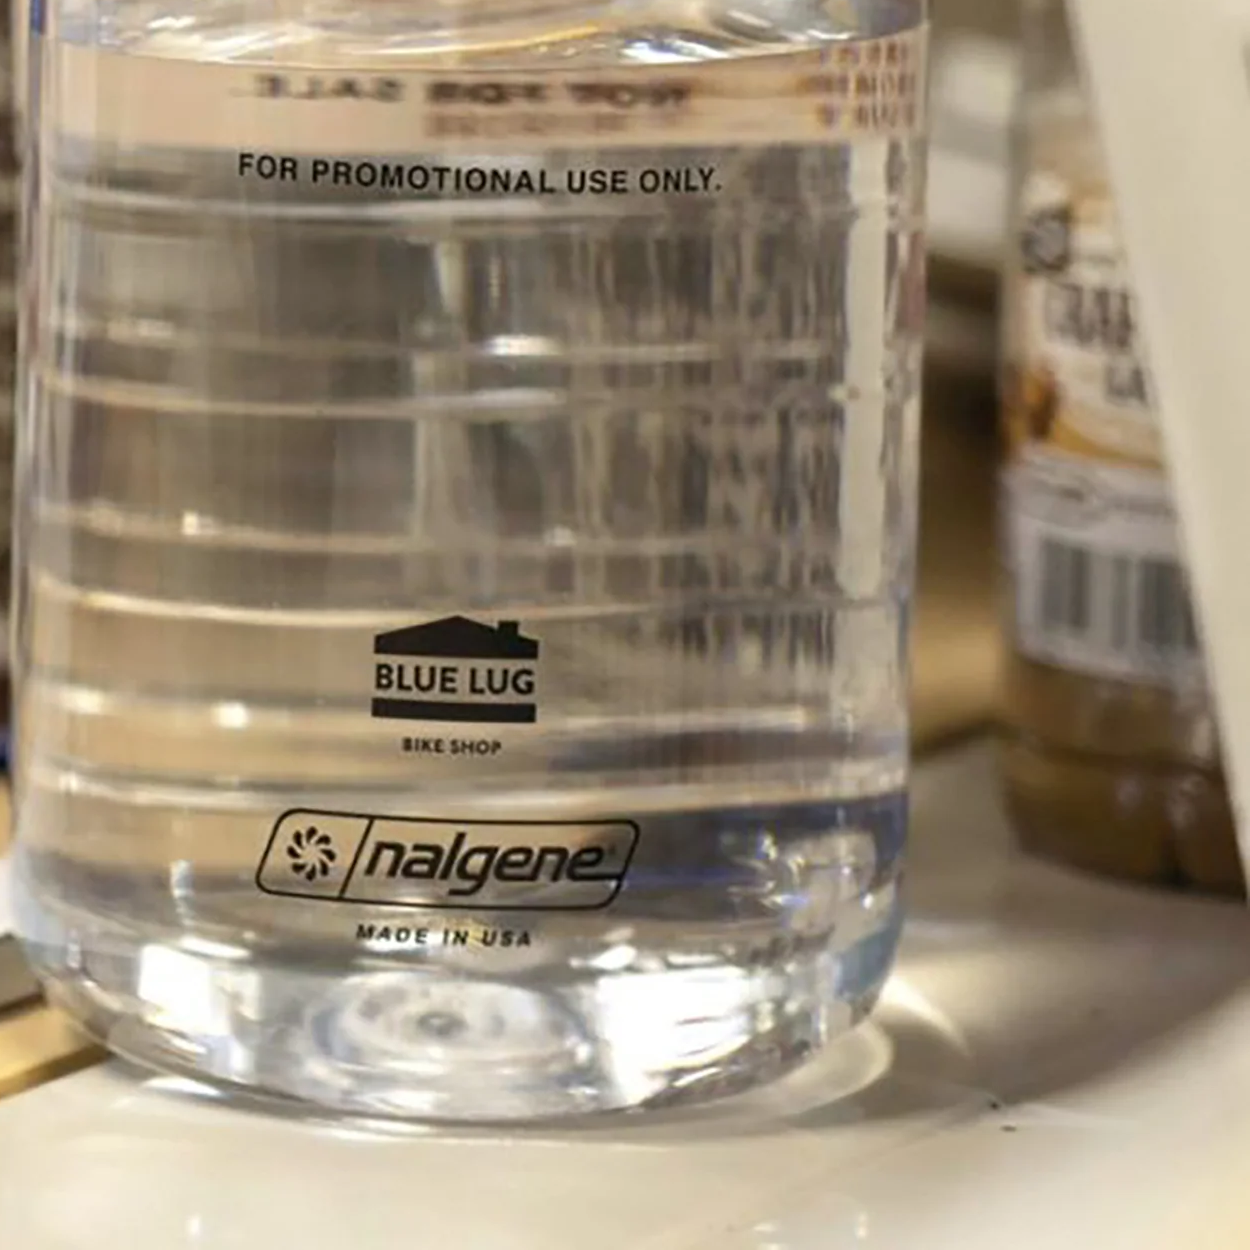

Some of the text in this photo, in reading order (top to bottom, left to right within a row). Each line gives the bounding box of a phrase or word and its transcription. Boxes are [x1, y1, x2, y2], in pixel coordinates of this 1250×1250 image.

[238, 153, 723, 195] FOR PROMOTIONAL USE ONLY.
[374, 662, 536, 696] BLUE LUG
[401, 737, 502, 756] BIKE SHOP
[363, 831, 618, 897] nalgene
[355, 923, 533, 948] MADE IN USA
